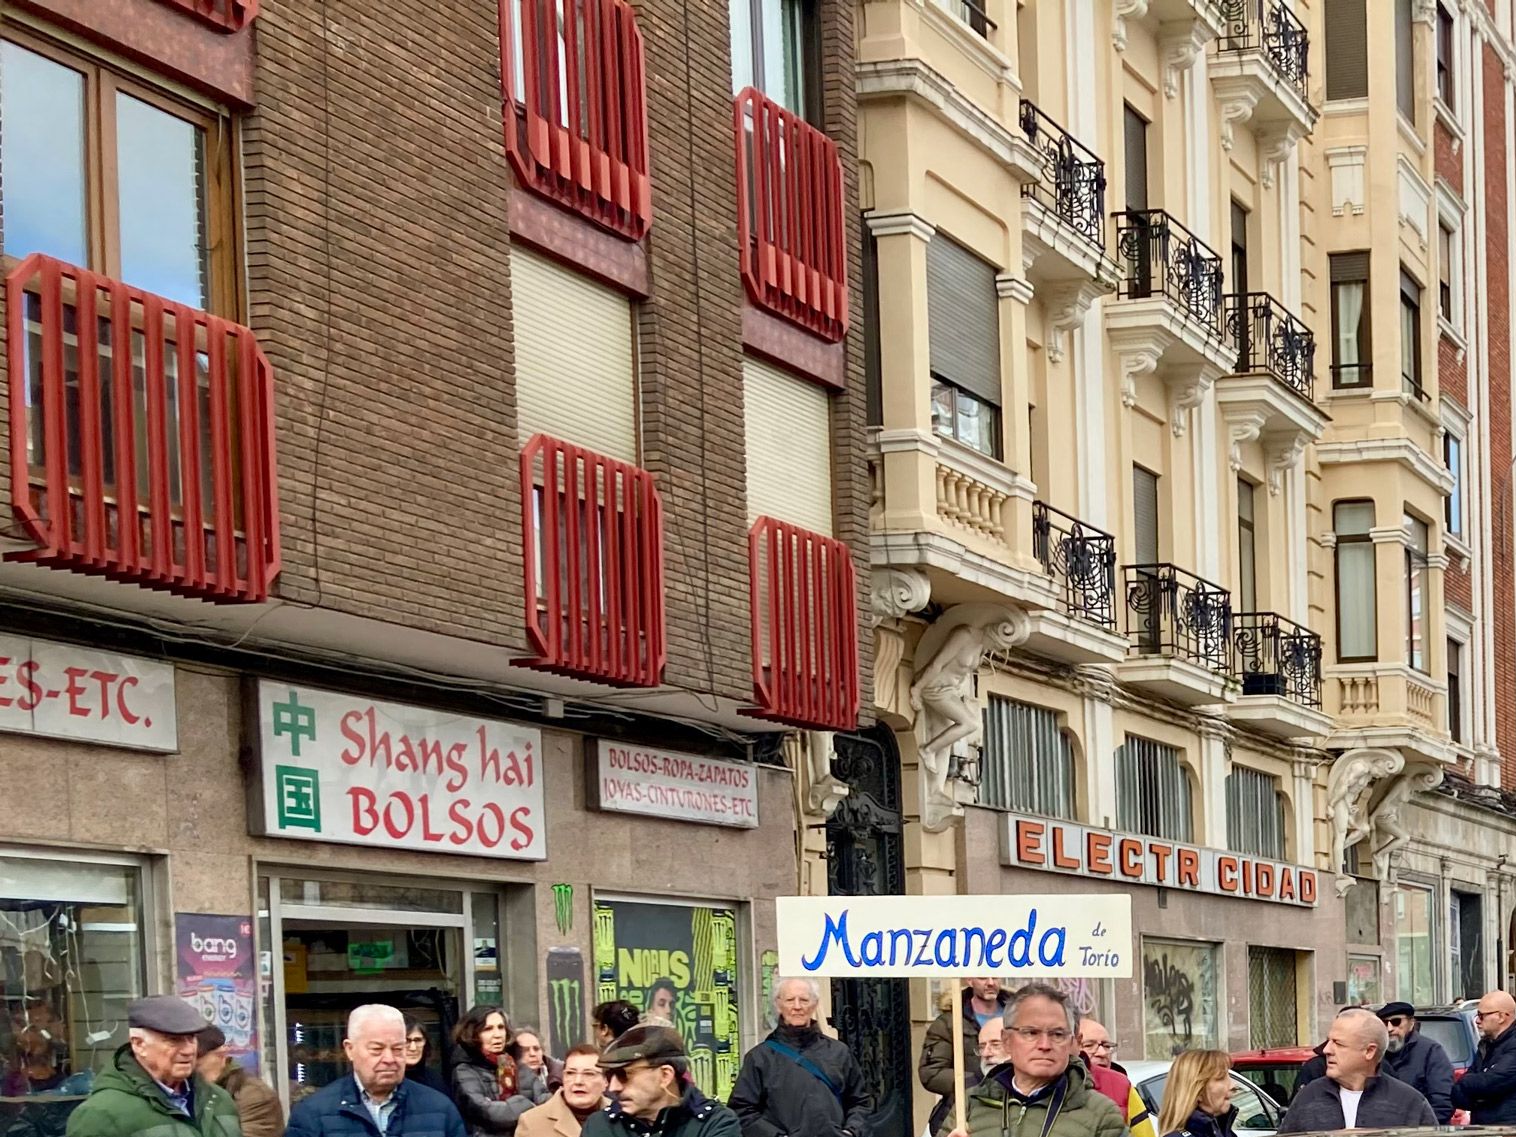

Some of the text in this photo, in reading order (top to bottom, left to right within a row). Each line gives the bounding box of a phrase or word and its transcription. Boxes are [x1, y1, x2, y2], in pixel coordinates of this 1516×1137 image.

[340, 706, 533, 792] Shang hai
[608, 747, 749, 788] BOLSOS-ROPA-ZAPATOS
[346, 786, 534, 851] BOLSOS
[1016, 819, 1317, 904] ELECTR CIDAD
[191, 932, 237, 958] bang
[801, 908, 1066, 971] Manzaneda
[1092, 921, 1107, 937] de
[1079, 944, 1119, 968] Torío
